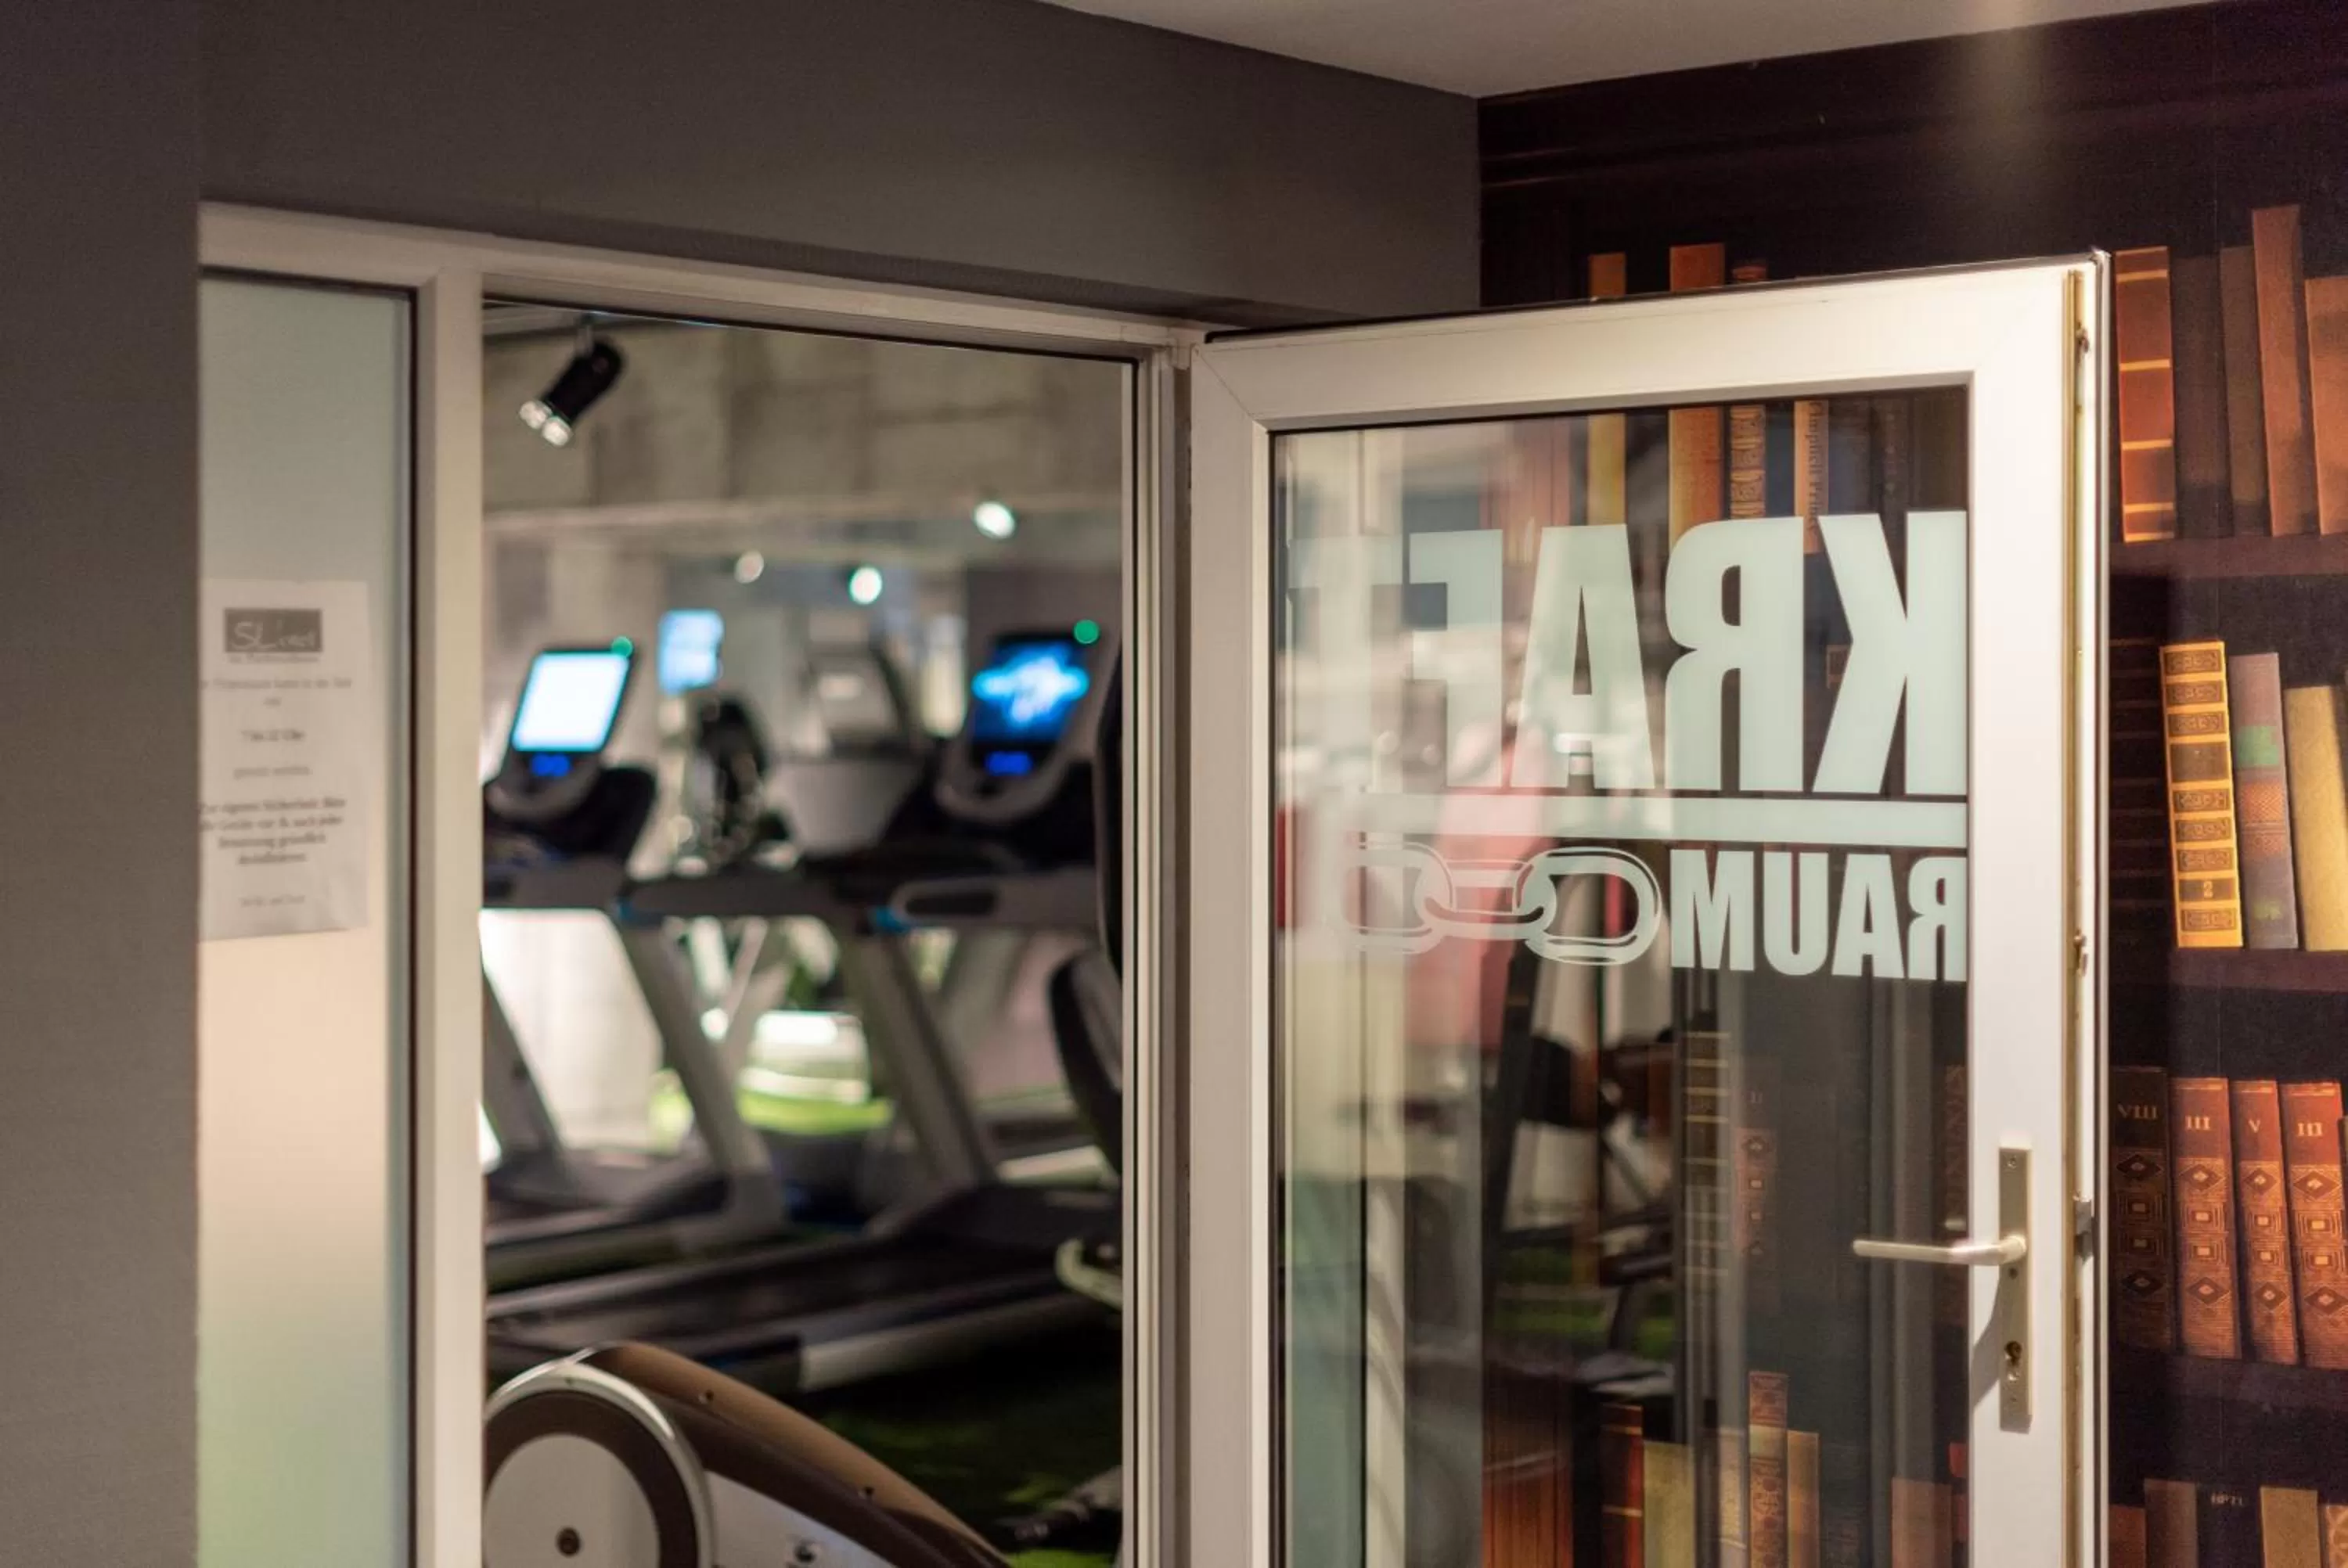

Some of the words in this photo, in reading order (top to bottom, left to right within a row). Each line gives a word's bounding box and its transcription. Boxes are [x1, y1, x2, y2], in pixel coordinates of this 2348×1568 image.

[2202, 880, 2214, 898] 2
[2116, 1103, 2159, 1120] VIII
[2184, 1115, 2211, 1131] III
[2248, 1119, 2261, 1134] V
[2297, 1121, 2324, 1138] III
